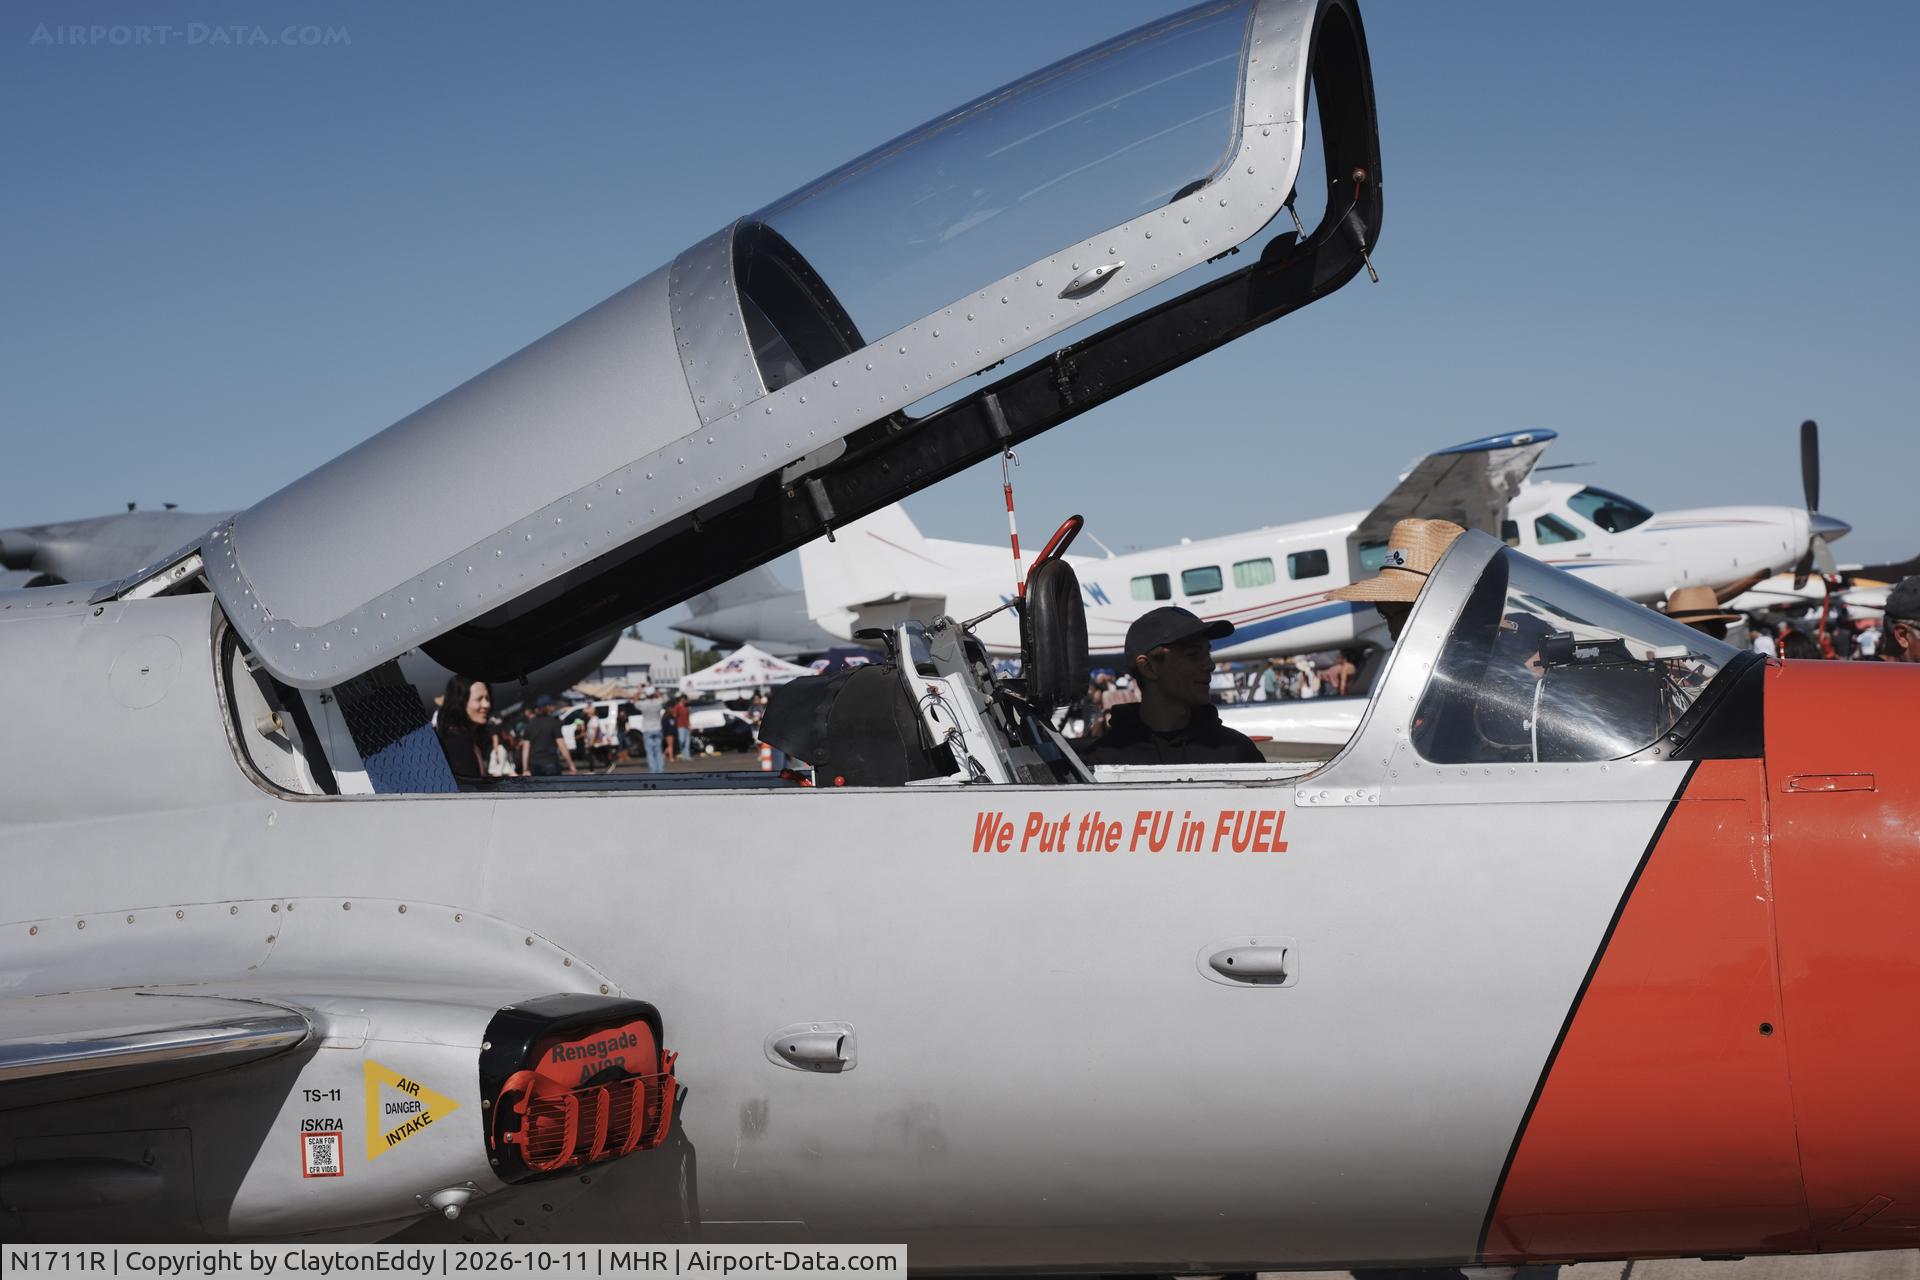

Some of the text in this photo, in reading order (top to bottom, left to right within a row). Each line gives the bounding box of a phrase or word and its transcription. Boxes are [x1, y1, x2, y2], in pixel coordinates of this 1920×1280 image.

[972, 810, 1289, 853] We Put the FU in FUEL
[551, 1032, 638, 1063] Renegade
[303, 1089, 341, 1102] TS-11
[396, 1078, 420, 1097] AIR
[385, 1101, 421, 1115] DANGER
[301, 1118, 343, 1132] ISKRA
[386, 1112, 433, 1146] INTAKE
[308, 1137, 323, 1145] SCAN
